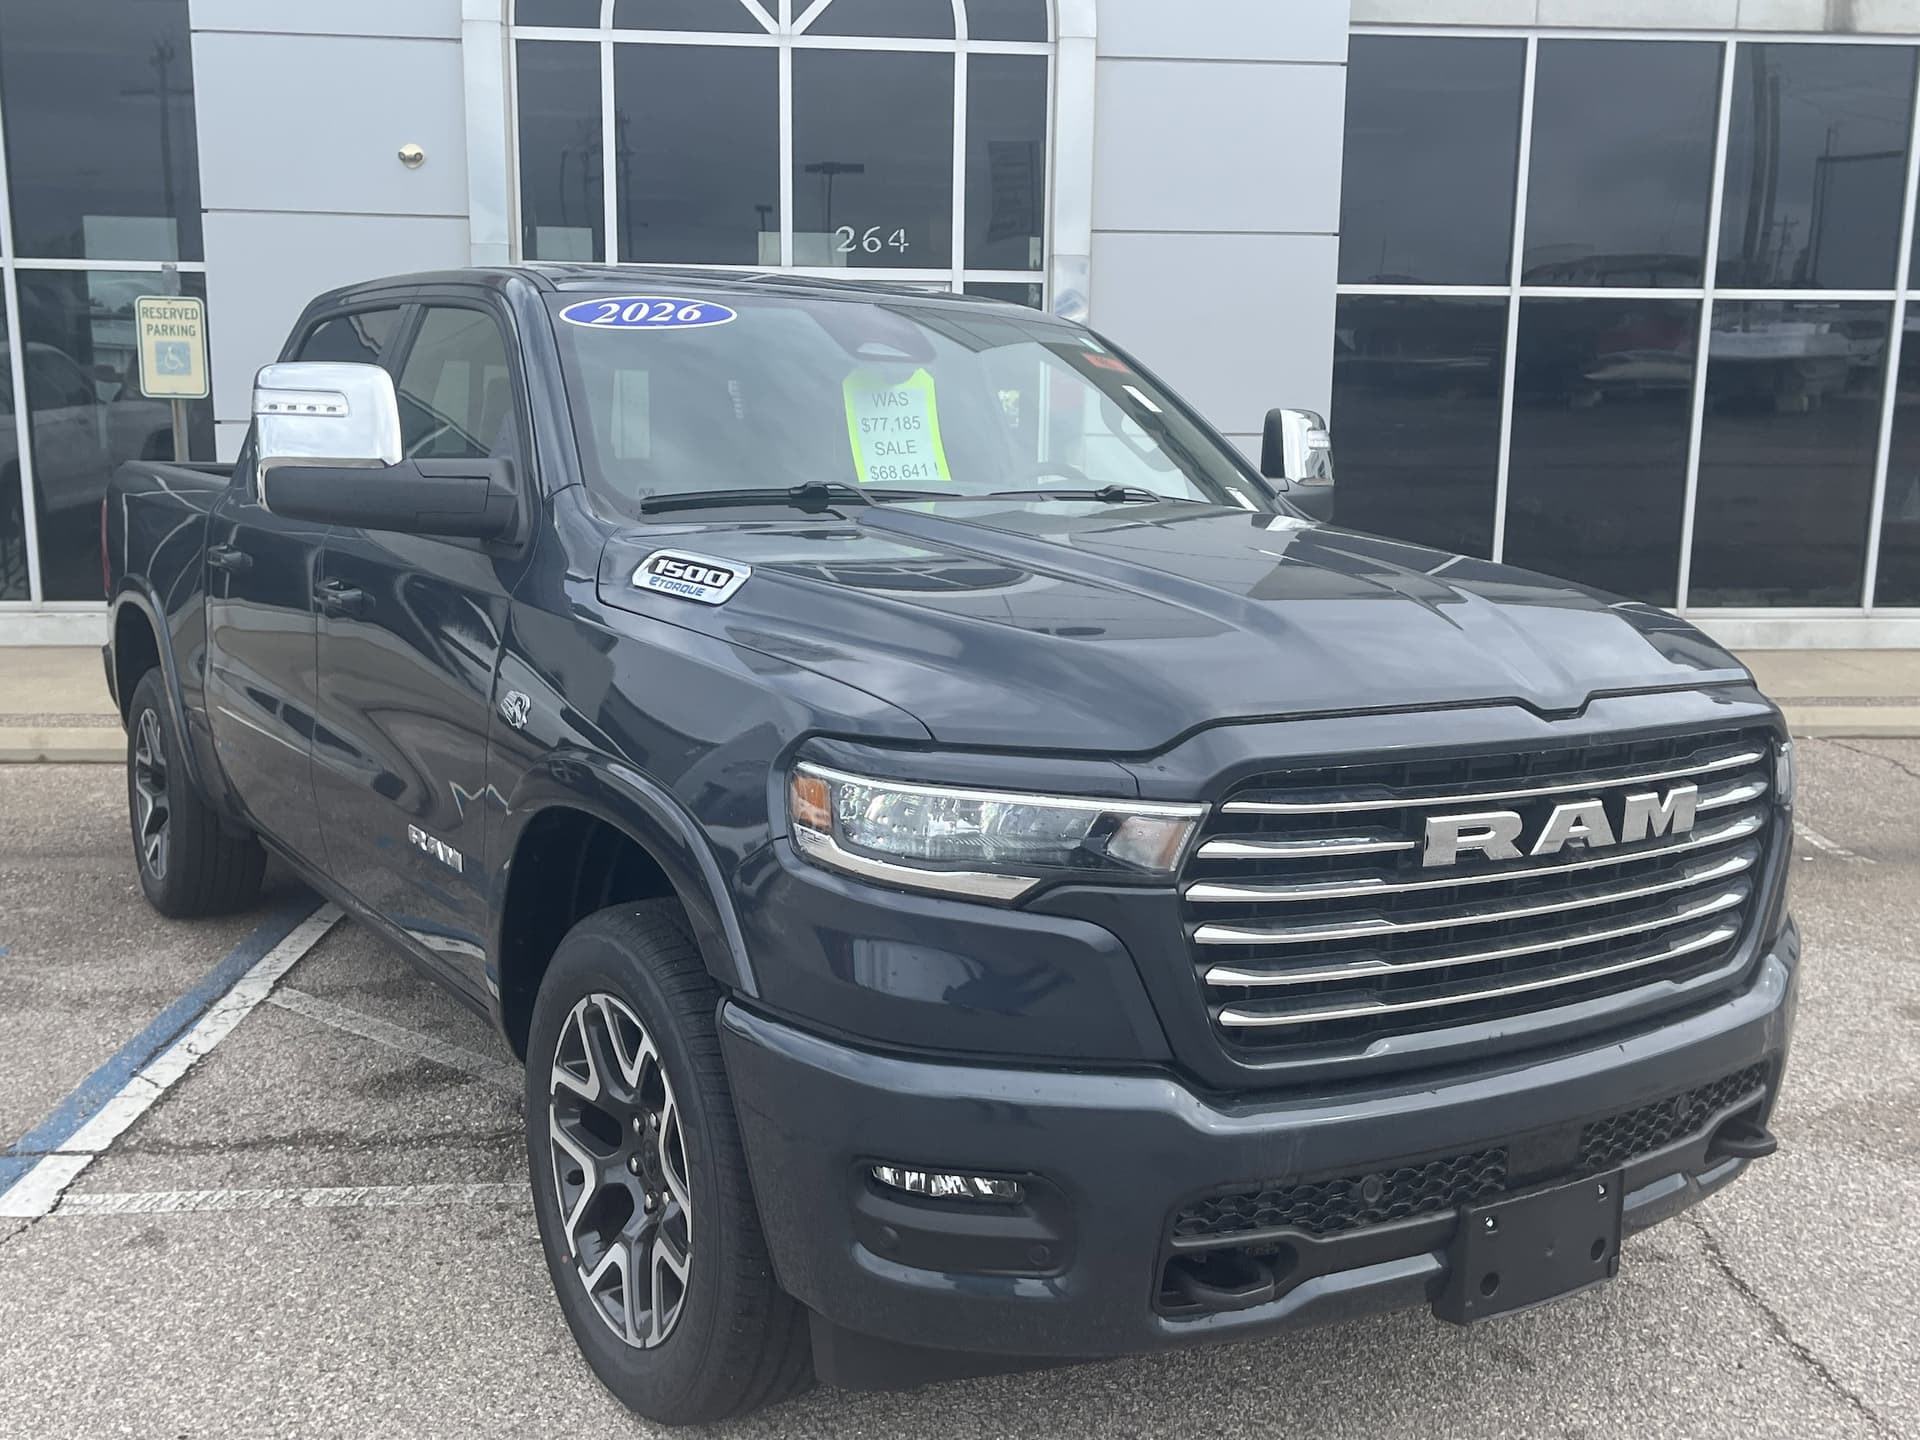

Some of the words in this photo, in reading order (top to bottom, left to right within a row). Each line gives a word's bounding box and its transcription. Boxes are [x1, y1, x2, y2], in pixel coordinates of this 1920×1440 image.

[835, 225, 910, 253] 264
[141, 306, 199, 320] RESERVED
[591, 302, 706, 324] 2026
[146, 323, 196, 337] PARKING
[871, 391, 909, 408] WAS
[861, 415, 921, 433] $77,185
[874, 439, 918, 456] SALE
[654, 559, 731, 588] 1500
[1422, 784, 1699, 868] RAM
[407, 823, 464, 873] RAM
